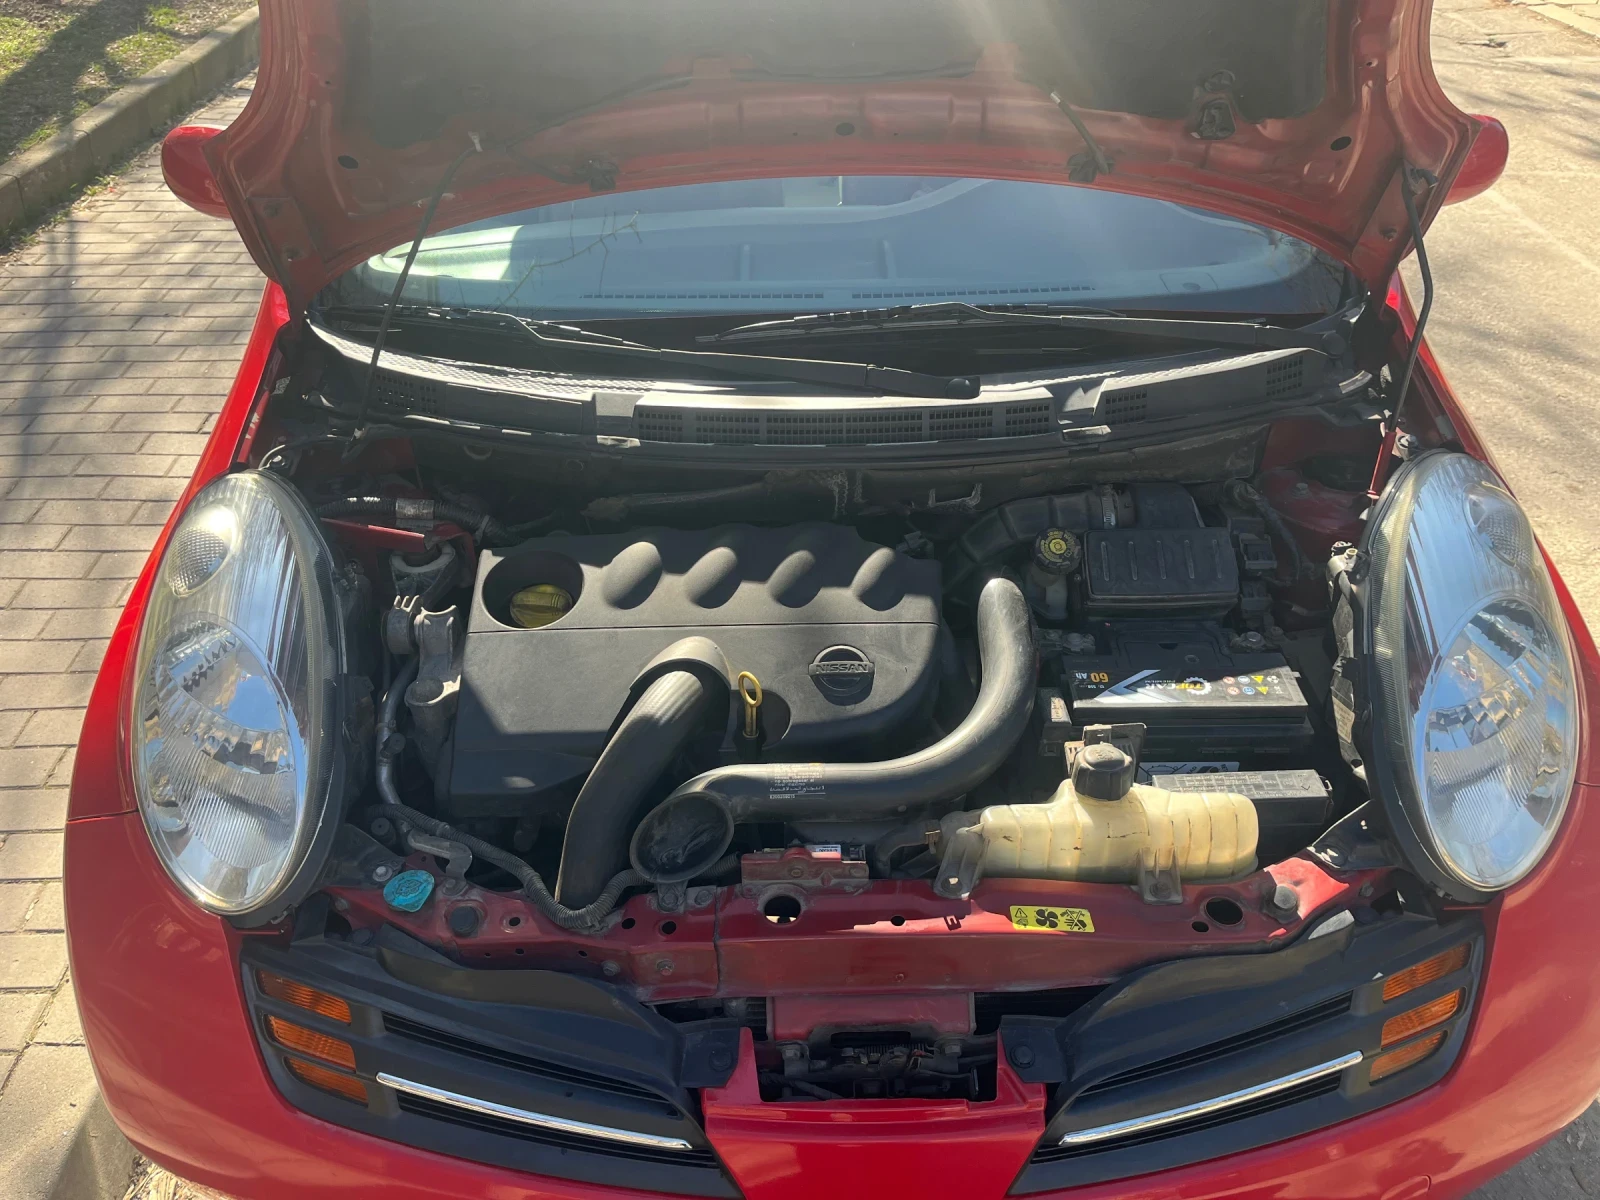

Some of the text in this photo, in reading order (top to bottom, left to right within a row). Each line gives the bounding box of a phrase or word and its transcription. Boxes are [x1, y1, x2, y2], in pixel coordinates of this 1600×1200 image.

[815, 663, 869, 674] NISSAN
[1075, 672, 1087, 680] Ah
[1090, 672, 1109, 683] 60
